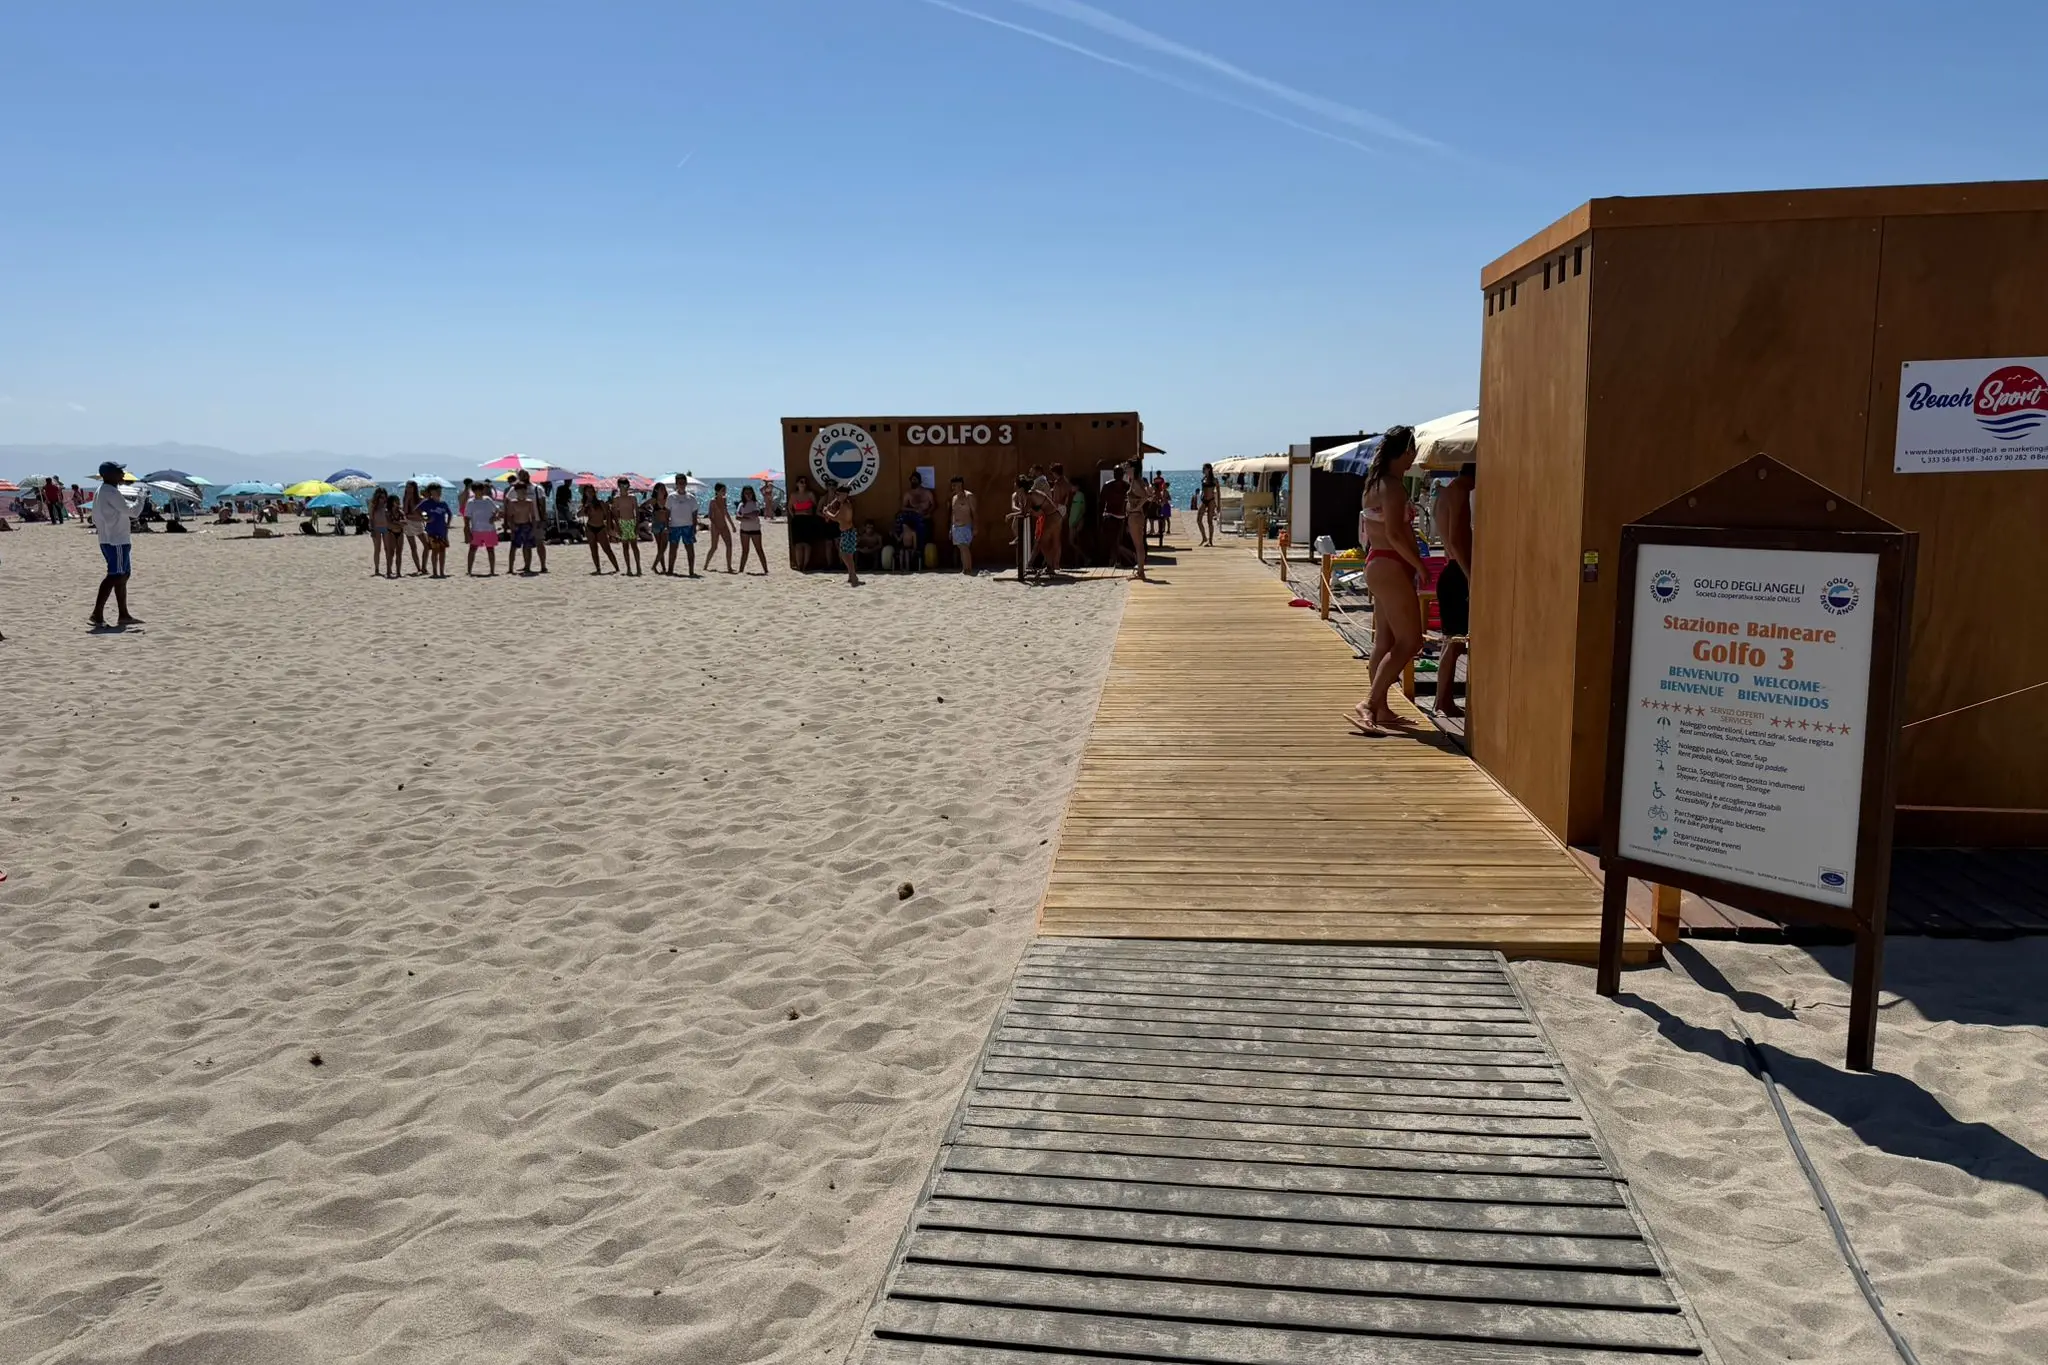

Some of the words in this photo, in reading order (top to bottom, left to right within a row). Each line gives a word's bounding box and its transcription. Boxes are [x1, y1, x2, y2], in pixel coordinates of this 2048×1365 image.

[1906, 382, 1973, 411] Beach
[1978, 379, 2045, 412] Sport
[821, 427, 865, 445] GOLFO
[906, 425, 992, 445] GOLFO
[998, 425, 1012, 445] 3
[1909, 447, 1997, 456] www.beachsportvillage.it
[848, 457, 876, 491] NGELI
[1655, 569, 1677, 579] GOLFO
[1693, 579, 1729, 590] GOLFO
[1730, 580, 1762, 592] DEGLI
[1764, 583, 1805, 595] ANGELI
[1826, 578, 1854, 588] GOLFO
[1650, 585, 1661, 604] DEGLI
[1662, 585, 1680, 604] ANGELI
[1695, 590, 1717, 599] Società
[1717, 593, 1754, 602] cooperativa
[1754, 594, 1776, 602] sociale
[1820, 595, 1835, 614] DEGLI
[1836, 595, 1859, 615] ANGELI
[1663, 615, 1740, 636] Stazione
[1746, 621, 1837, 644] Balneare
[1692, 640, 1766, 668] Golfo
[1778, 647, 1794, 670] 3
[1669, 666, 1740, 684] BENVENUTO
[1753, 675, 1821, 693] WELCOME
[1660, 680, 1725, 697] BIENVENUE
[1738, 689, 1830, 710] BIENVENIDOS
[1709, 706, 1735, 716] SERVIZI
[1736, 709, 1765, 719] OFFERTI
[1719, 715, 1753, 726] SERVICES
[1679, 719, 1707, 730] Noleggio
[1678, 742, 1706, 753] Noleggio
[1754, 754, 1768, 763] Sup
[1735, 759, 1754, 768] Stand
[1755, 763, 1764, 771] up
[1764, 764, 1788, 773] paddle
[1768, 780, 1805, 791] indumenti
[1710, 801, 1721, 809] for
[1744, 808, 1767, 817] person
[1674, 816, 1687, 825] Free
[1700, 822, 1724, 834] parking
[1721, 840, 1742, 851] eventi
